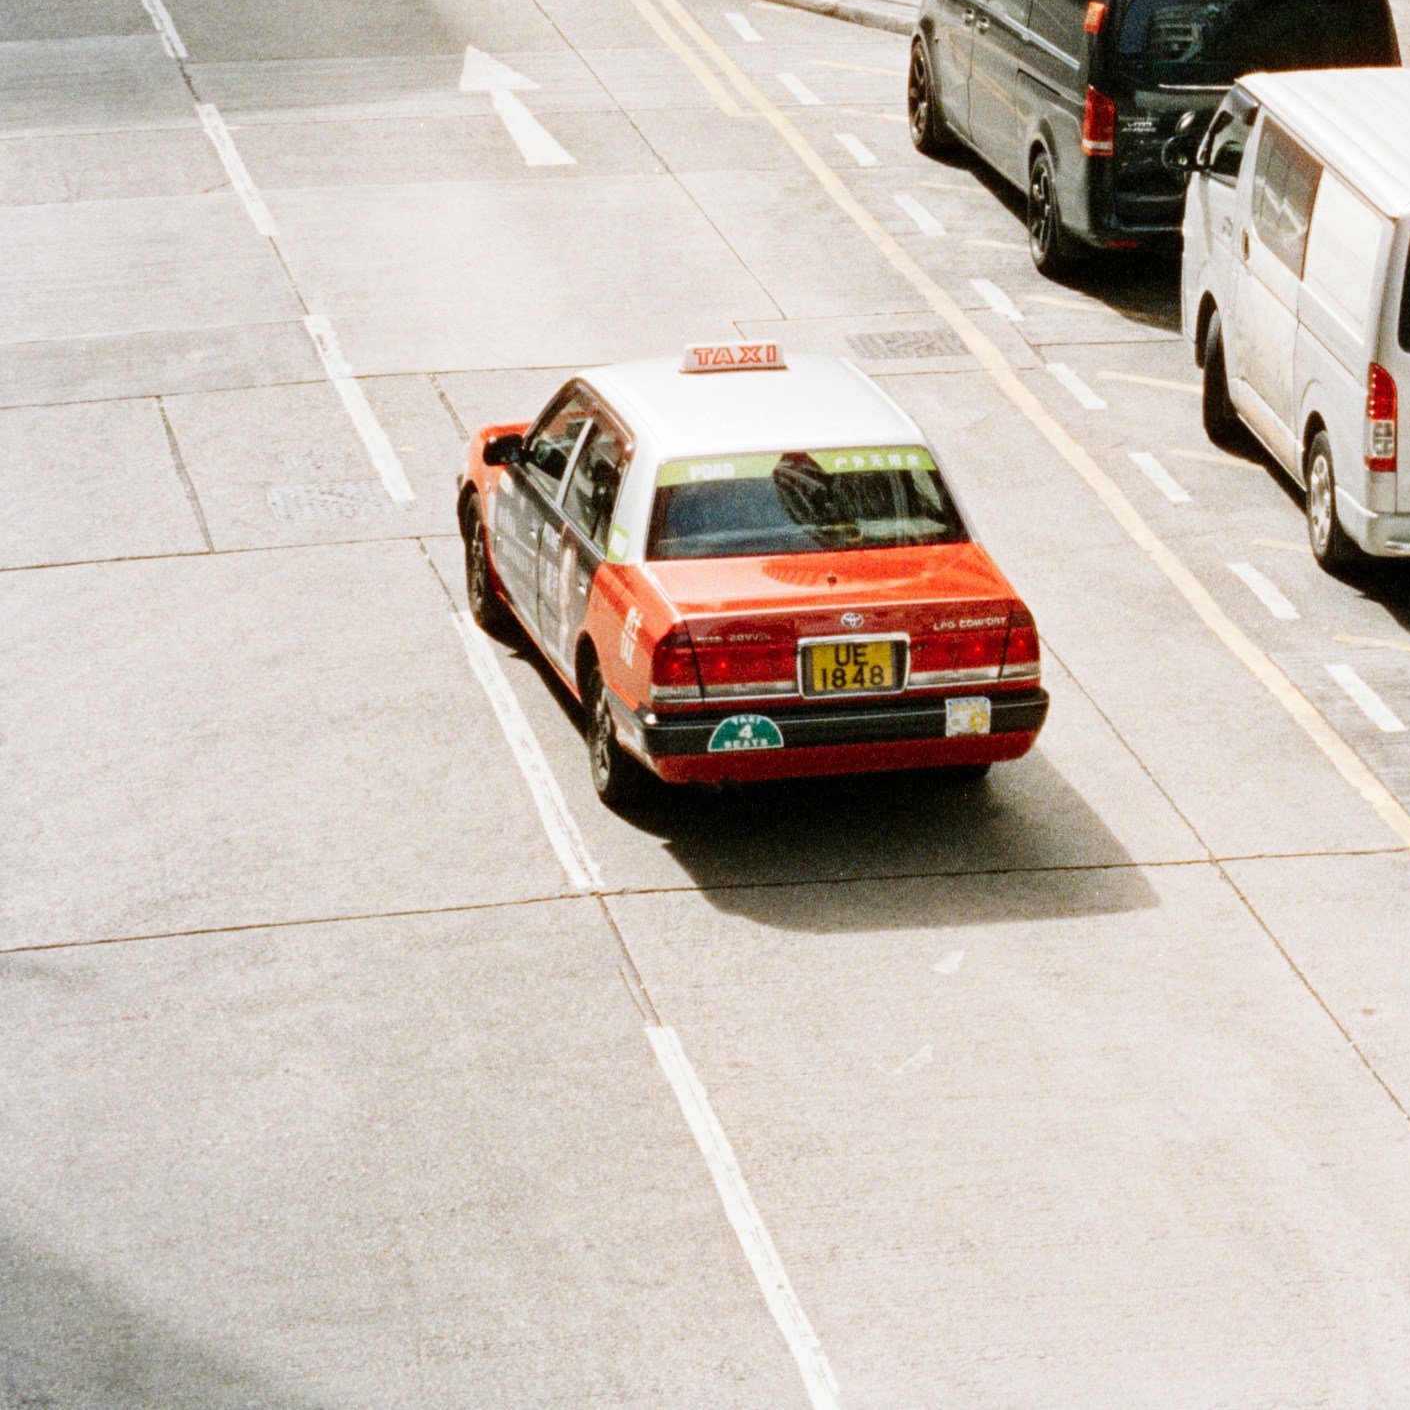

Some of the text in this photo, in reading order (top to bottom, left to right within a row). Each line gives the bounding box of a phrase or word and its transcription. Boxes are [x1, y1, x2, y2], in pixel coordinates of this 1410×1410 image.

[694, 344, 777, 367] TAXI
[834, 644, 869, 666] UE
[822, 666, 885, 689] 1848
[740, 725, 753, 739] 4
[723, 738, 769, 750] SEATS
